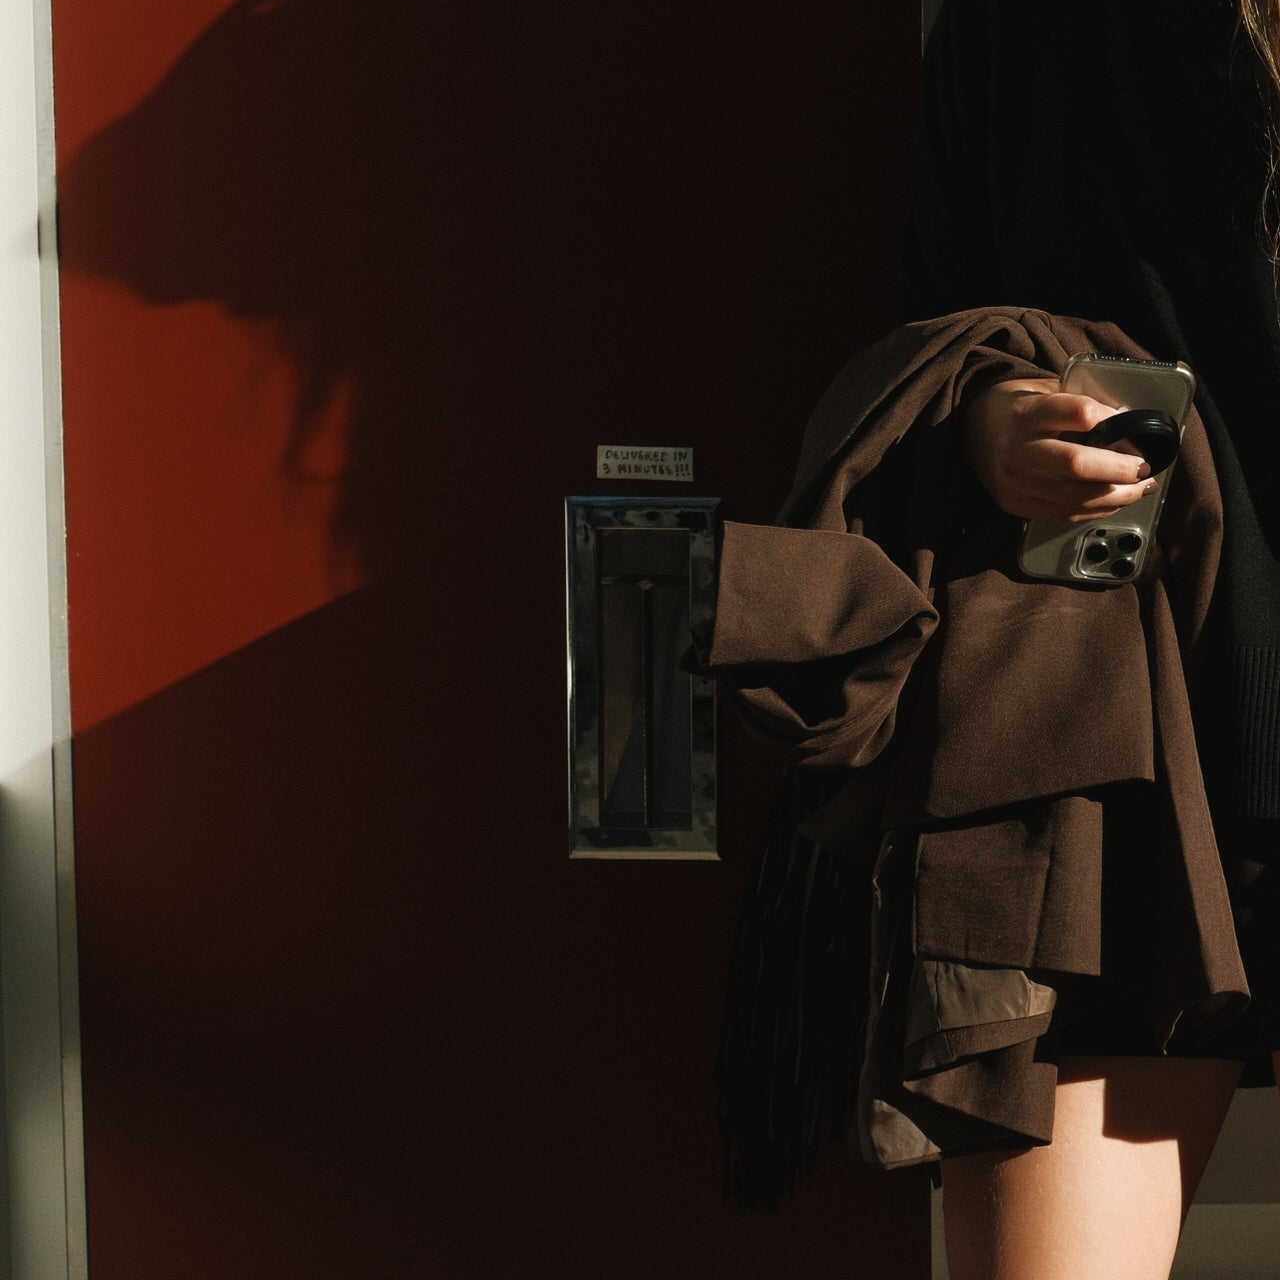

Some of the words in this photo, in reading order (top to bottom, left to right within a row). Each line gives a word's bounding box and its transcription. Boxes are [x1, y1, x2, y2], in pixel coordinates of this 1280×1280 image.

[605, 449, 667, 462] DELIVERED
[673, 451, 688, 462] IN
[602, 463, 611, 474] 3
